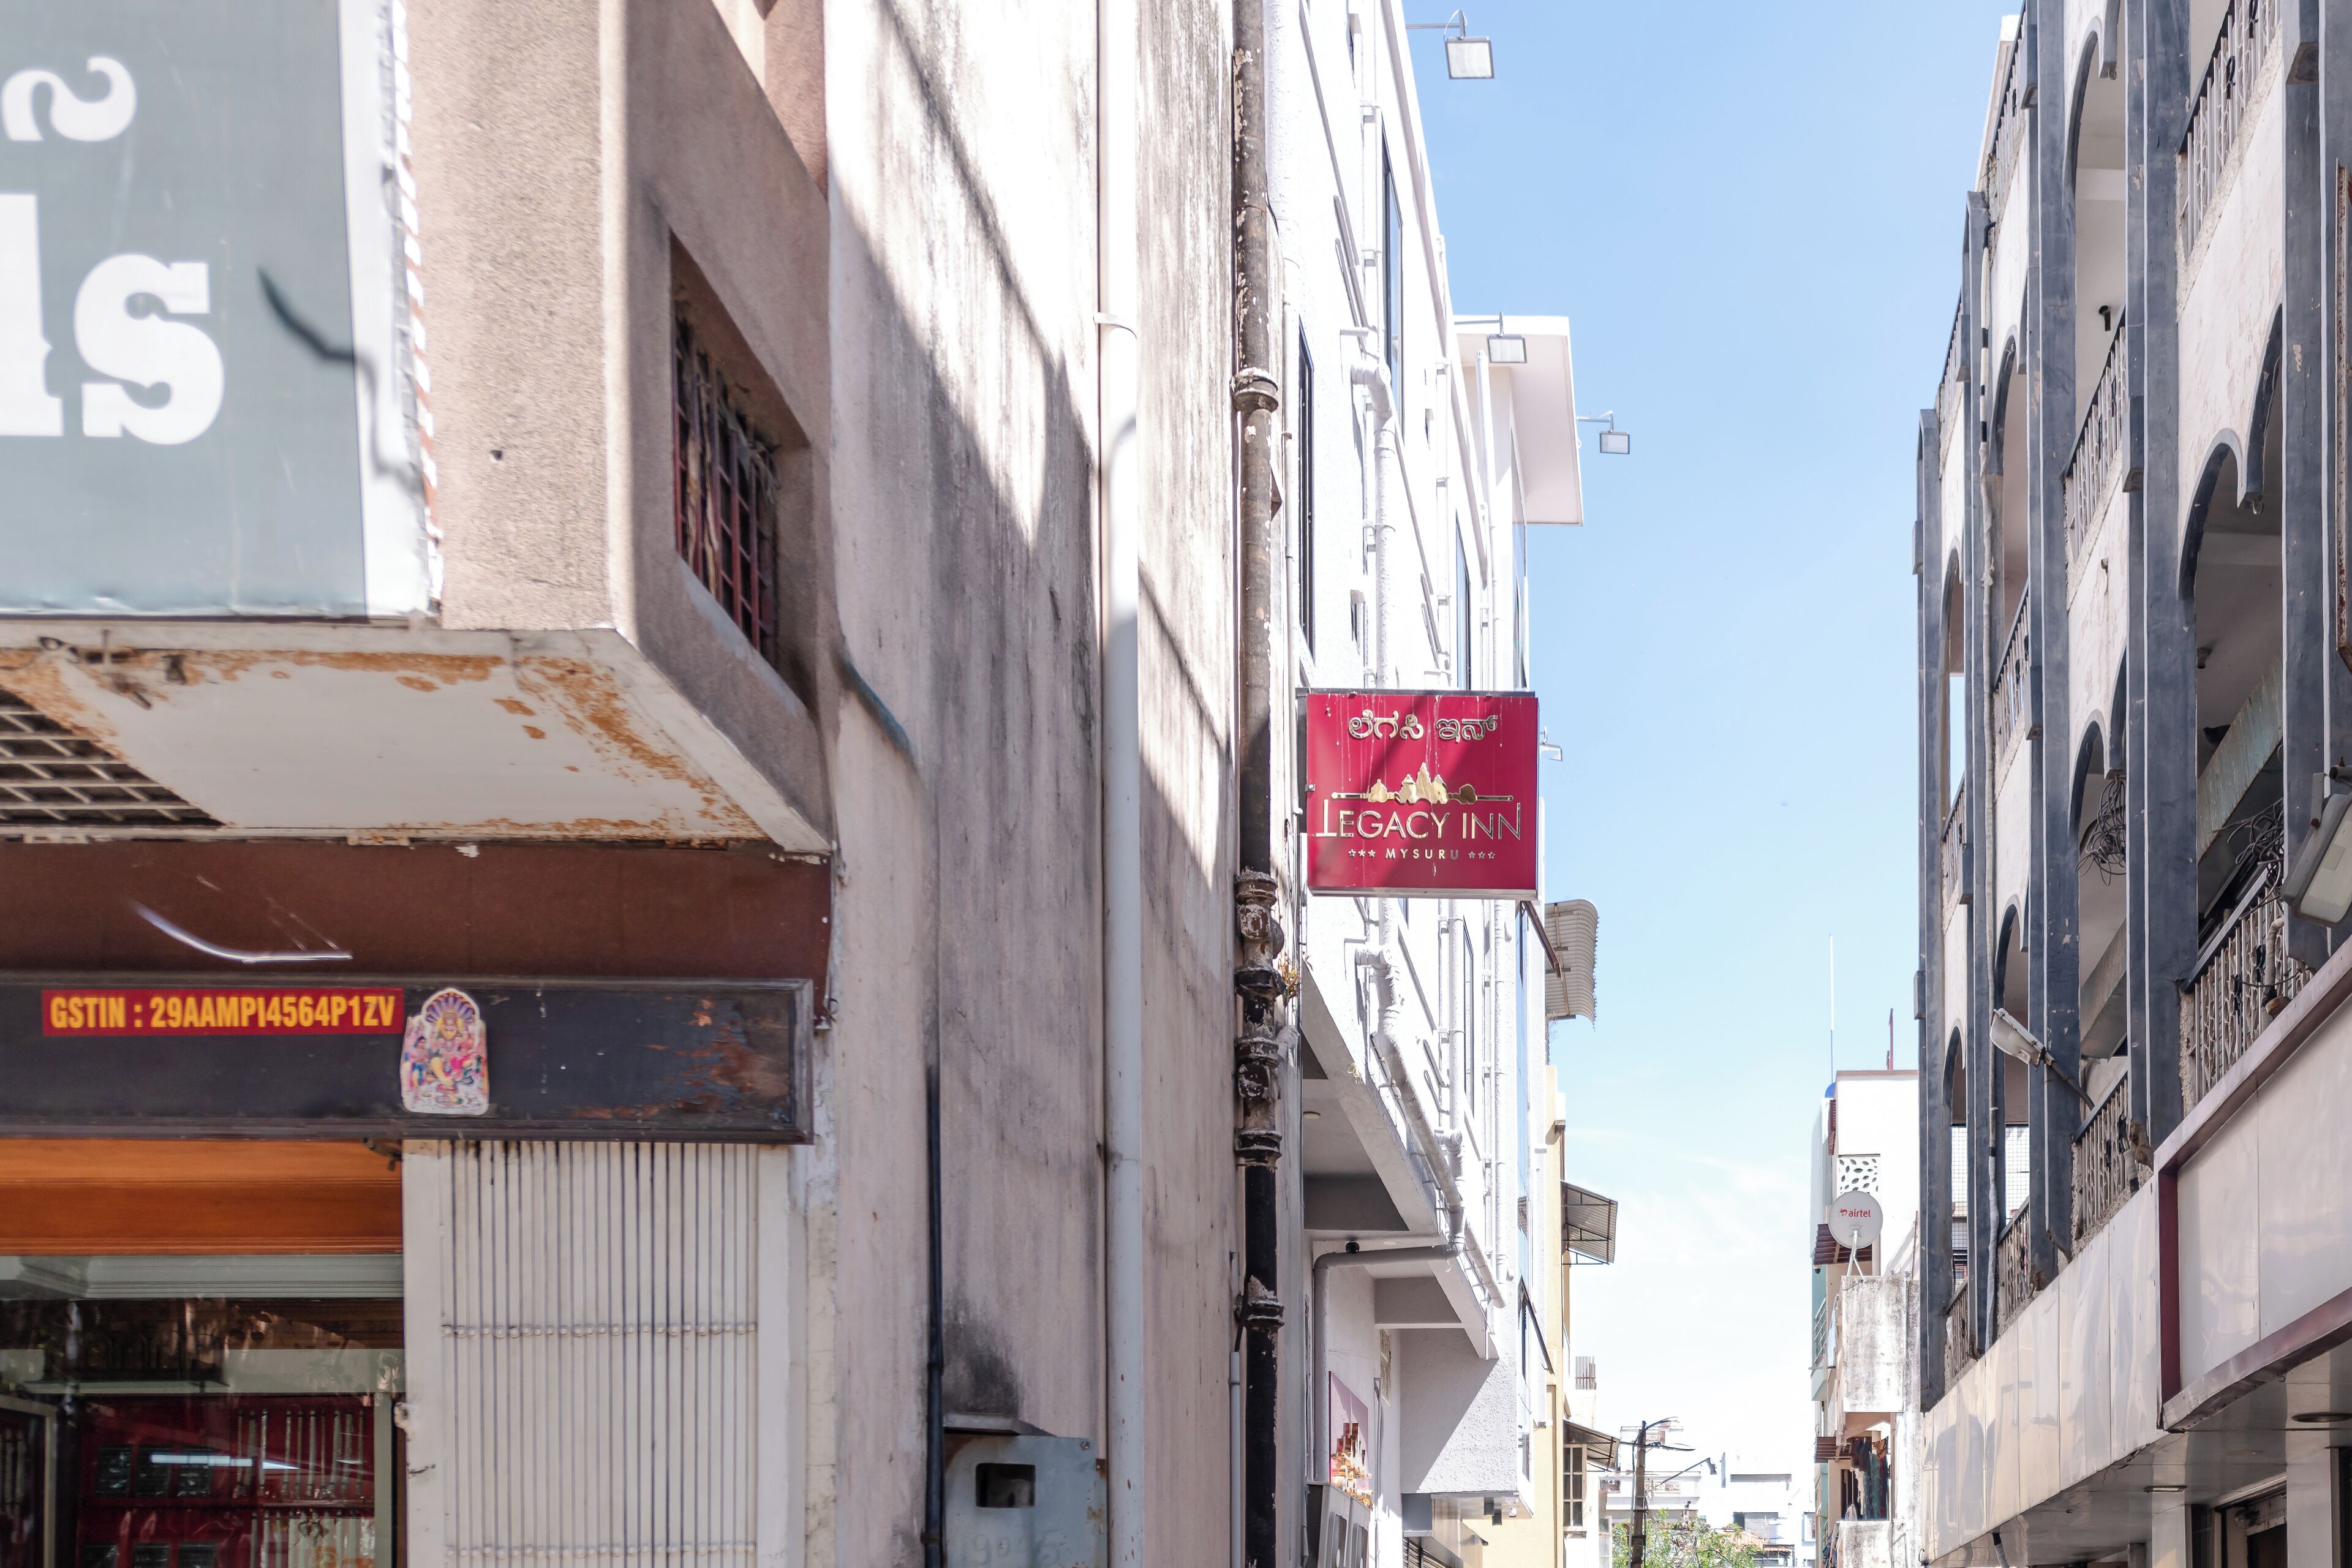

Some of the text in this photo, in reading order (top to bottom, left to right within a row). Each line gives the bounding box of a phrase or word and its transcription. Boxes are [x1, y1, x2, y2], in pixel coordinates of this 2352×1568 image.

[1436, 714, 1499, 744] ಇನ್
[1315, 799, 1521, 841] LEGACY INN
[1385, 848, 1459, 860] MYSURU
[50, 996, 126, 1029] GSTIN
[1849, 1208, 1871, 1218] airtel
